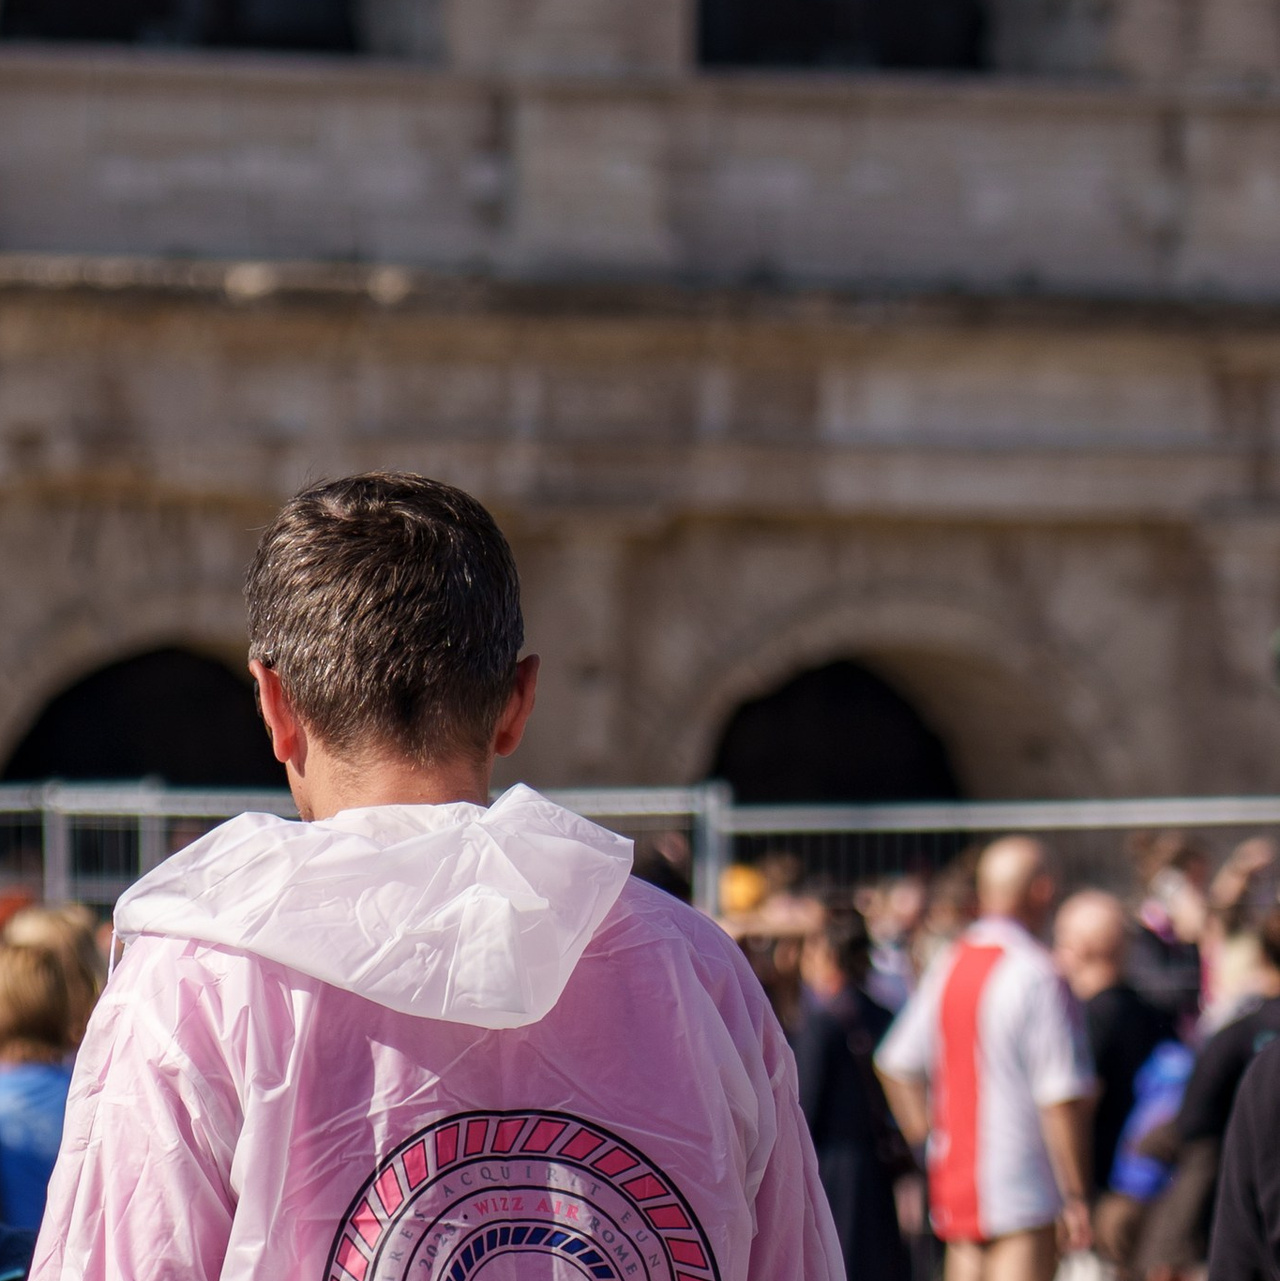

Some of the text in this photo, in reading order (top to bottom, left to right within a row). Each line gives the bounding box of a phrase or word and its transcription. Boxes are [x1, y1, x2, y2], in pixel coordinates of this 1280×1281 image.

[443, 1165, 600, 1198] ACQUIRIT
[419, 1222, 457, 1271] 2025
[473, 1197, 524, 1217] WIZZ
[536, 1198, 580, 1222] AIR
[589, 1216, 638, 1276] ROME
